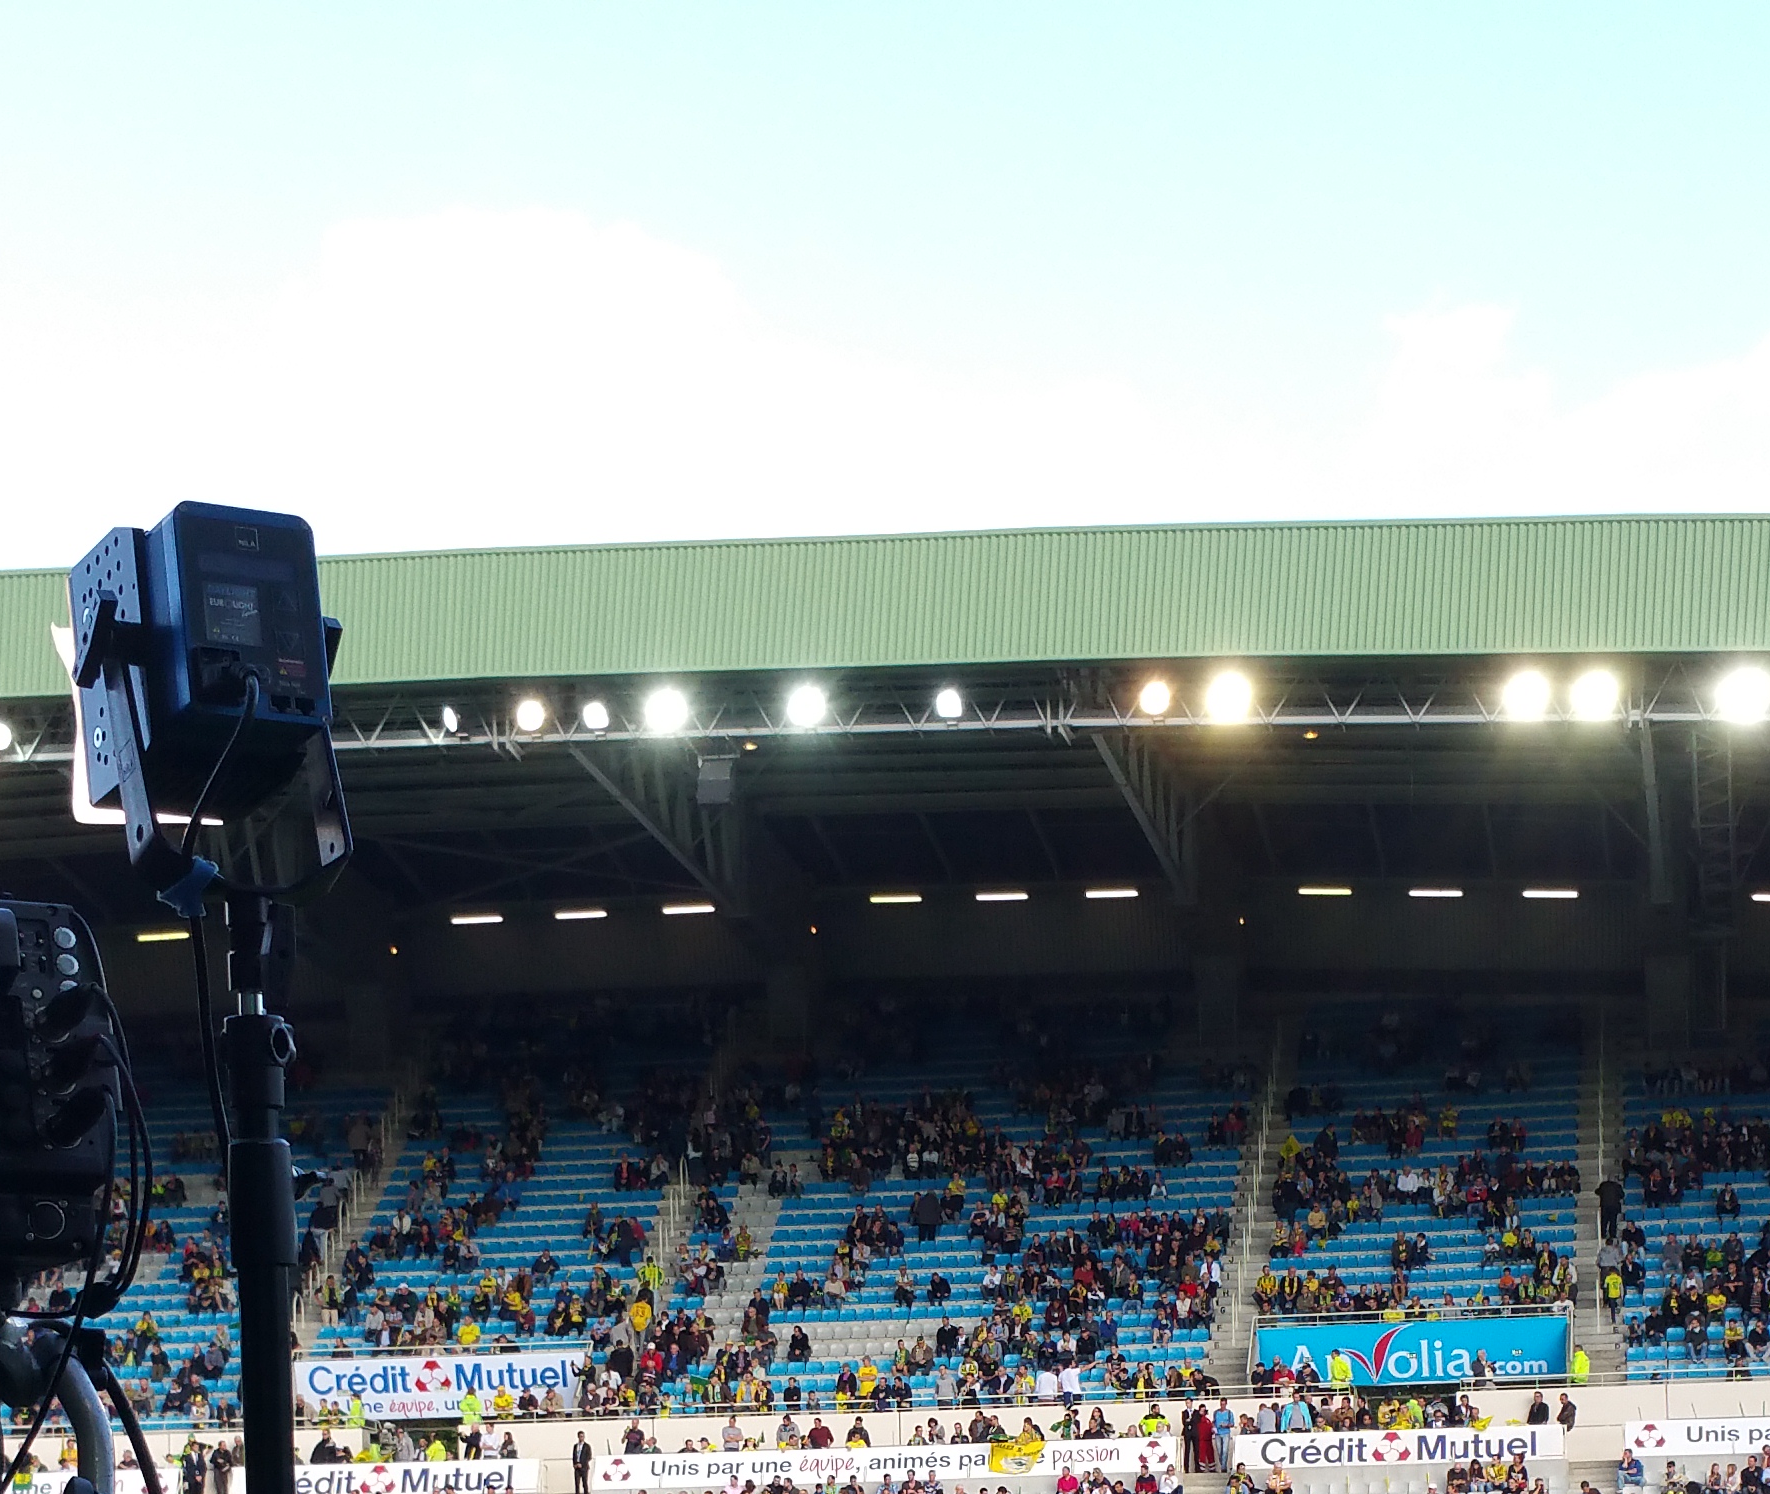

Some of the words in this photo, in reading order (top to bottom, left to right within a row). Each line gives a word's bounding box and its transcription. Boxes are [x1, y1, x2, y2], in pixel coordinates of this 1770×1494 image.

[308, 1363, 412, 1395] Crédit
[455, 1359, 568, 1391] Mutuel
[388, 1398, 440, 1418] équipe,
[1261, 1437, 1367, 1465] Crédit
[1417, 1431, 1537, 1461] Mutuel
[1686, 1425, 1739, 1444] Unis
[650, 1460, 699, 1477] Unis
[707, 1460, 744, 1479] par
[751, 1459, 792, 1475] une
[799, 1454, 861, 1479] équipe,
[869, 1450, 951, 1470] animés
[1052, 1445, 1120, 1471] passion
[401, 1464, 514, 1493] Mutuel
